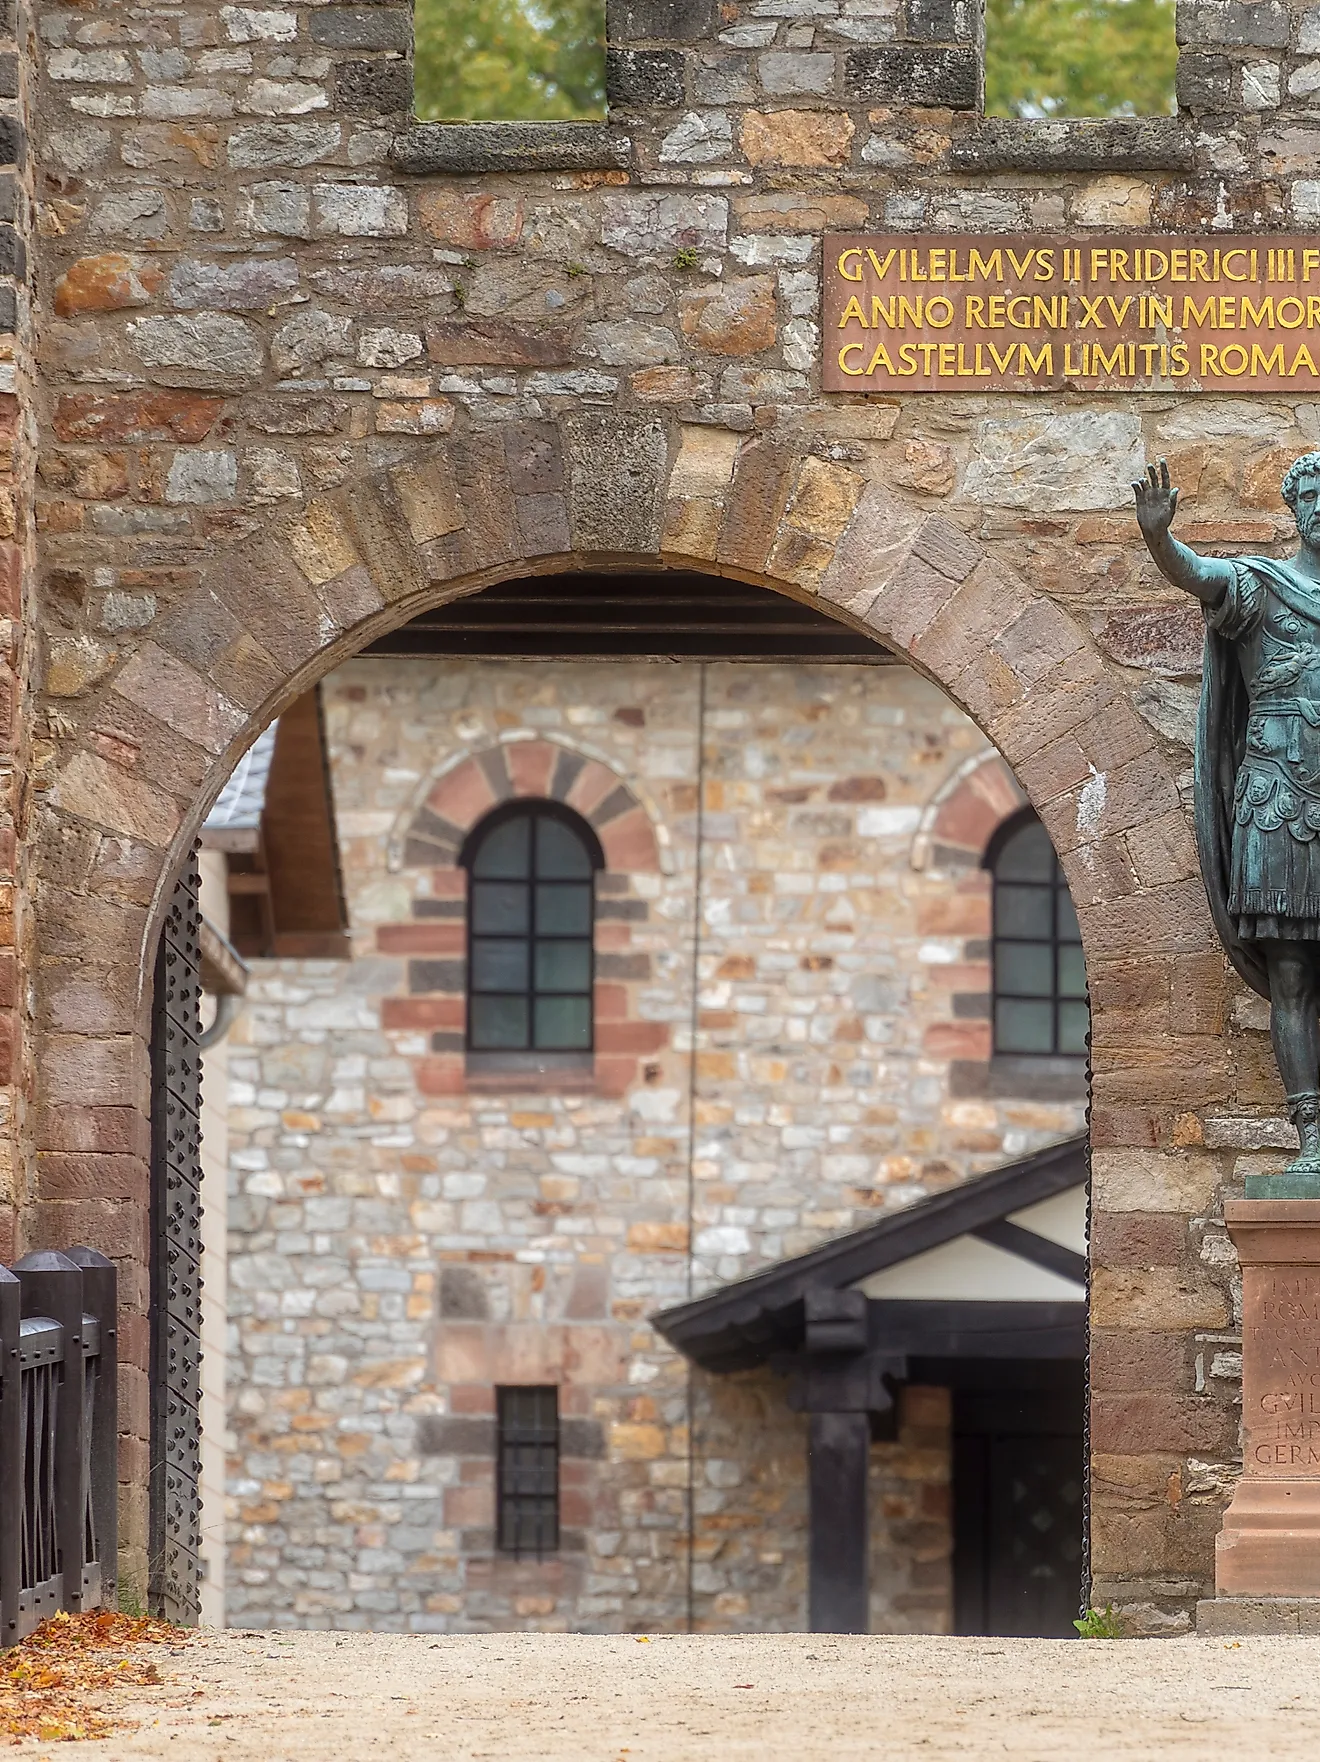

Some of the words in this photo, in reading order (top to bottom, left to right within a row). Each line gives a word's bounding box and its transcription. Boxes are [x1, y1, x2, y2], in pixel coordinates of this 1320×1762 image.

[835, 248, 1055, 282] GVILELMVS
[1063, 248, 1082, 282] II
[1088, 248, 1258, 282] FRIDERICI
[1267, 248, 1296, 282] III
[838, 294, 956, 330] ANNO
[965, 294, 1070, 330] REGNI
[1079, 294, 1132, 330] XV
[1136, 294, 1174, 330] IN
[837, 342, 1057, 377] CASTELLVM
[1062, 342, 1192, 377] LIMITIS
